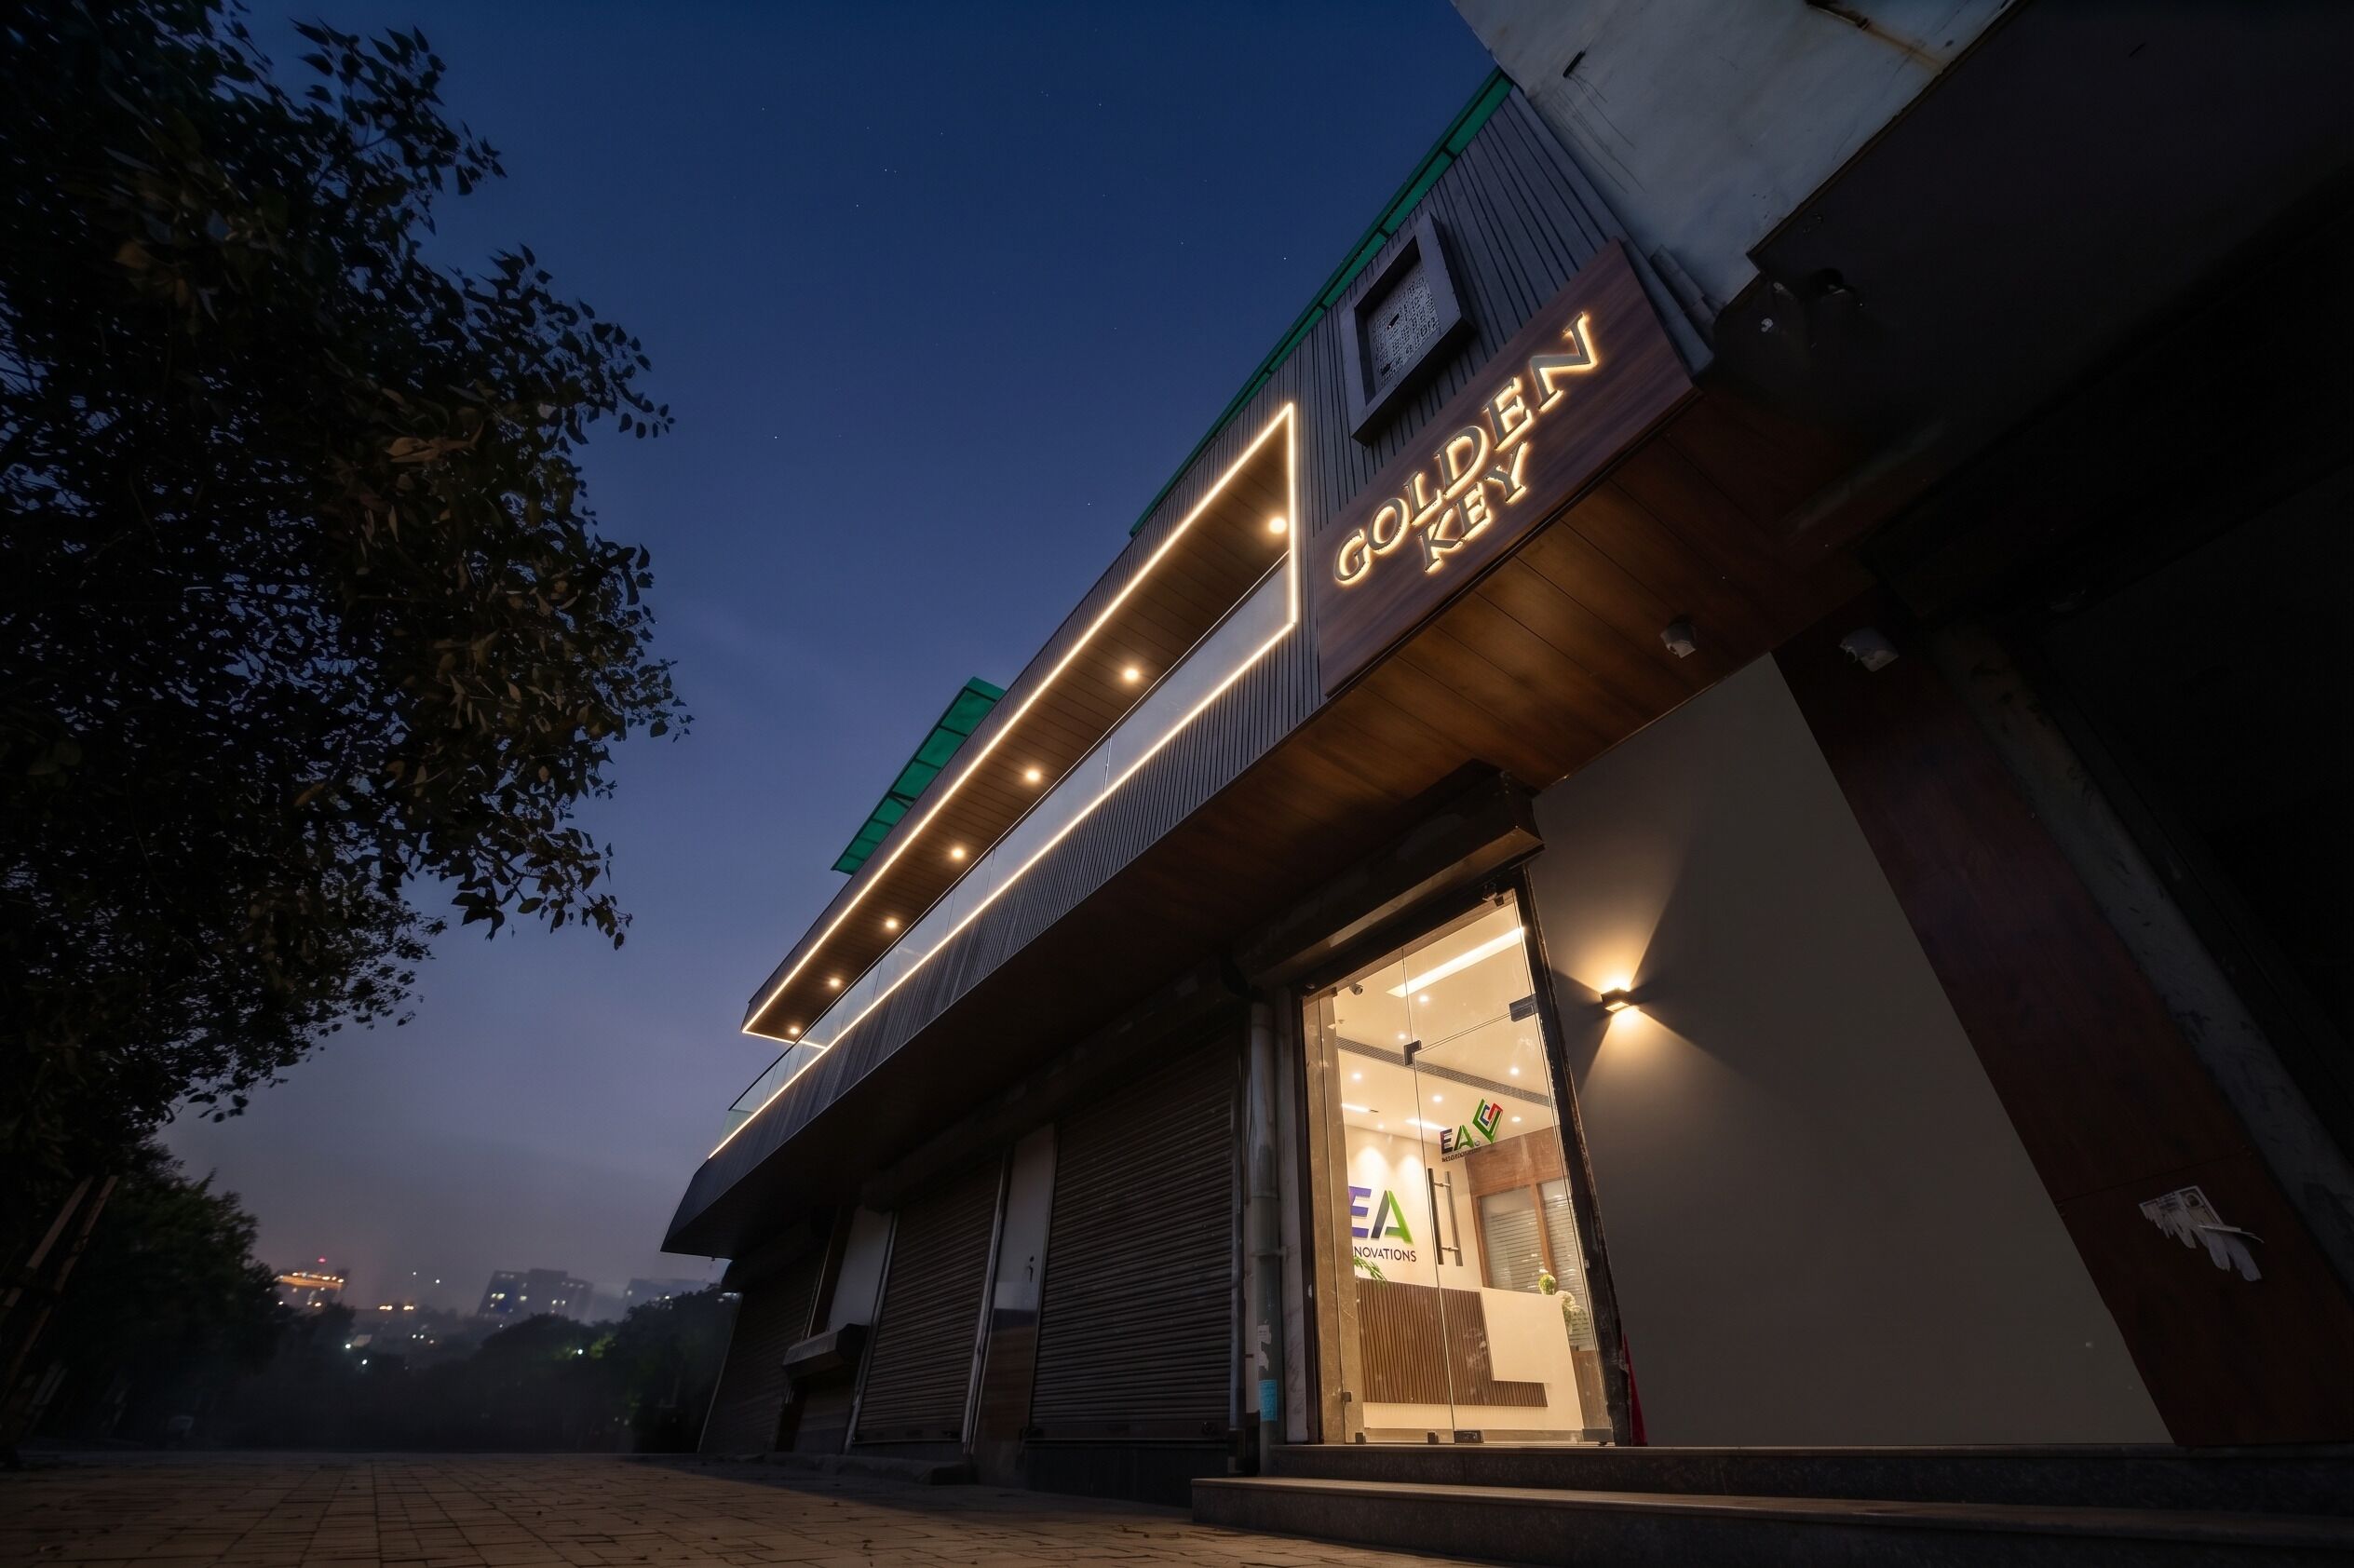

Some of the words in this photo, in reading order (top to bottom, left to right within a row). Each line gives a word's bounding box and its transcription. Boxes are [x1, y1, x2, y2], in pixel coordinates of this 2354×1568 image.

[1333, 311, 1598, 585] GOLDEN
[1418, 440, 1528, 573] KEY
[1440, 1124, 1474, 1154] EA
[1348, 1186, 1414, 1244] EA
